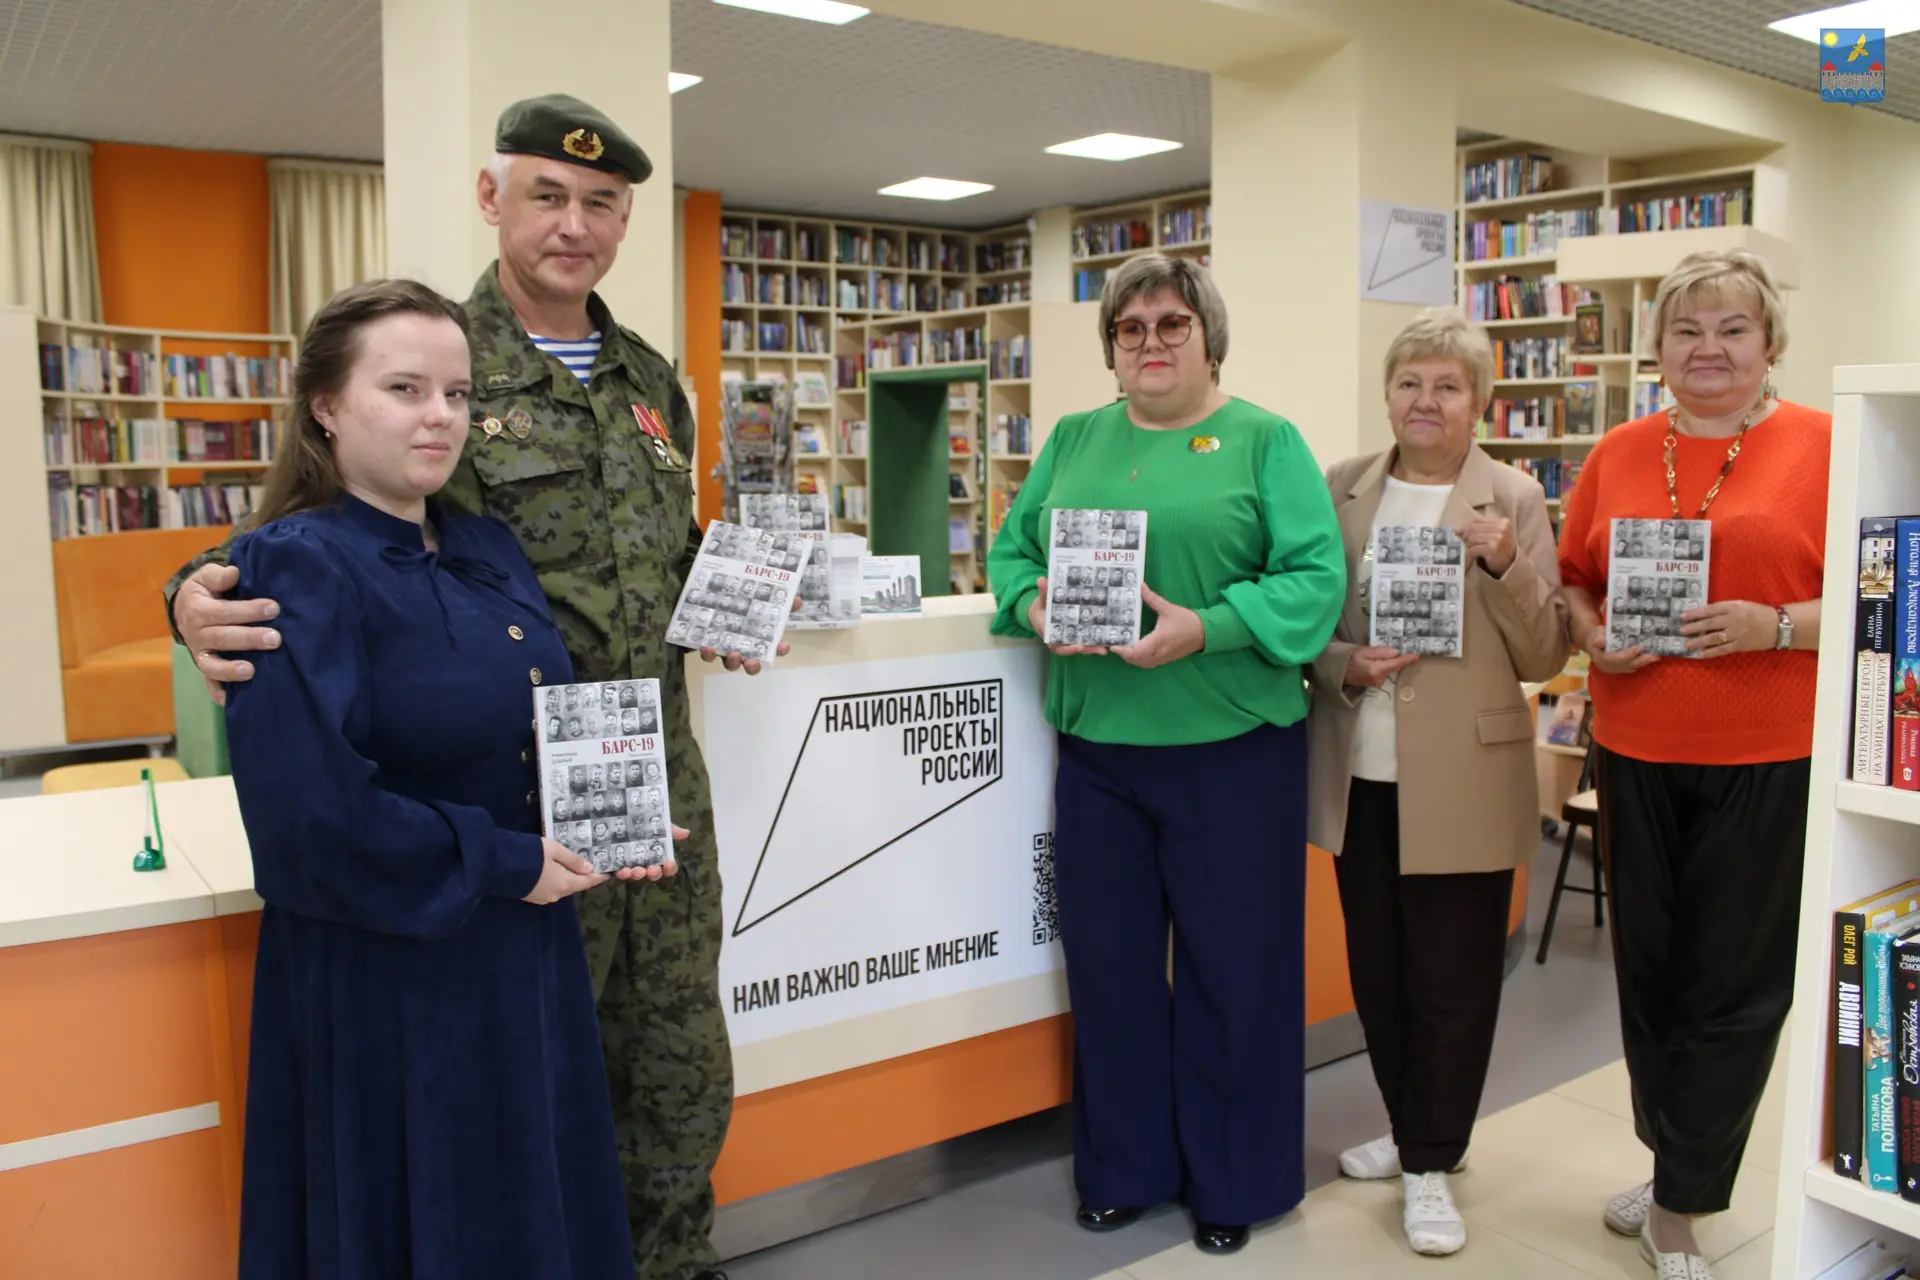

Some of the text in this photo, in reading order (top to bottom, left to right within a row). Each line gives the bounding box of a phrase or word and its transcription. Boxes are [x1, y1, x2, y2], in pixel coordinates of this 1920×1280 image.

[744, 564, 791, 582] БАРС-19
[1094, 551, 1135, 562] БАРС-19
[1417, 566, 1457, 577] БАРС-19
[1656, 561, 1699, 572] БАРС-19
[1905, 532, 1920, 654] Наталья Александрова
[1867, 614, 1875, 639] ЕЛЕНА
[1874, 602, 1883, 649] ПЕРВУШИНА
[825, 685, 998, 733] НАЦИОНАЛЬНЫЕ
[1858, 659, 1872, 774] ЛИТЕРАТУРНЫЕ ГЕРОИ
[1873, 658, 1887, 777] НА УЛИЦАХ ПЕТЕРБУРГА
[601, 737, 655, 755] БАРС-19
[903, 717, 998, 756] ПРОЕКТЫ
[921, 748, 998, 786] РОССИИ
[1843, 924, 1856, 966] ОЛЕГ РОЙ
[732, 930, 999, 1014] НАМ ВАЖНО ВАШЕ МНЕНИЕ
[1838, 981, 1862, 1048] ДВОЙНИК
[1876, 1014, 1888, 1031] Две
[1902, 998, 1920, 1085] Островская
[1881, 1076, 1895, 1153] ПОЛЯКОВА
